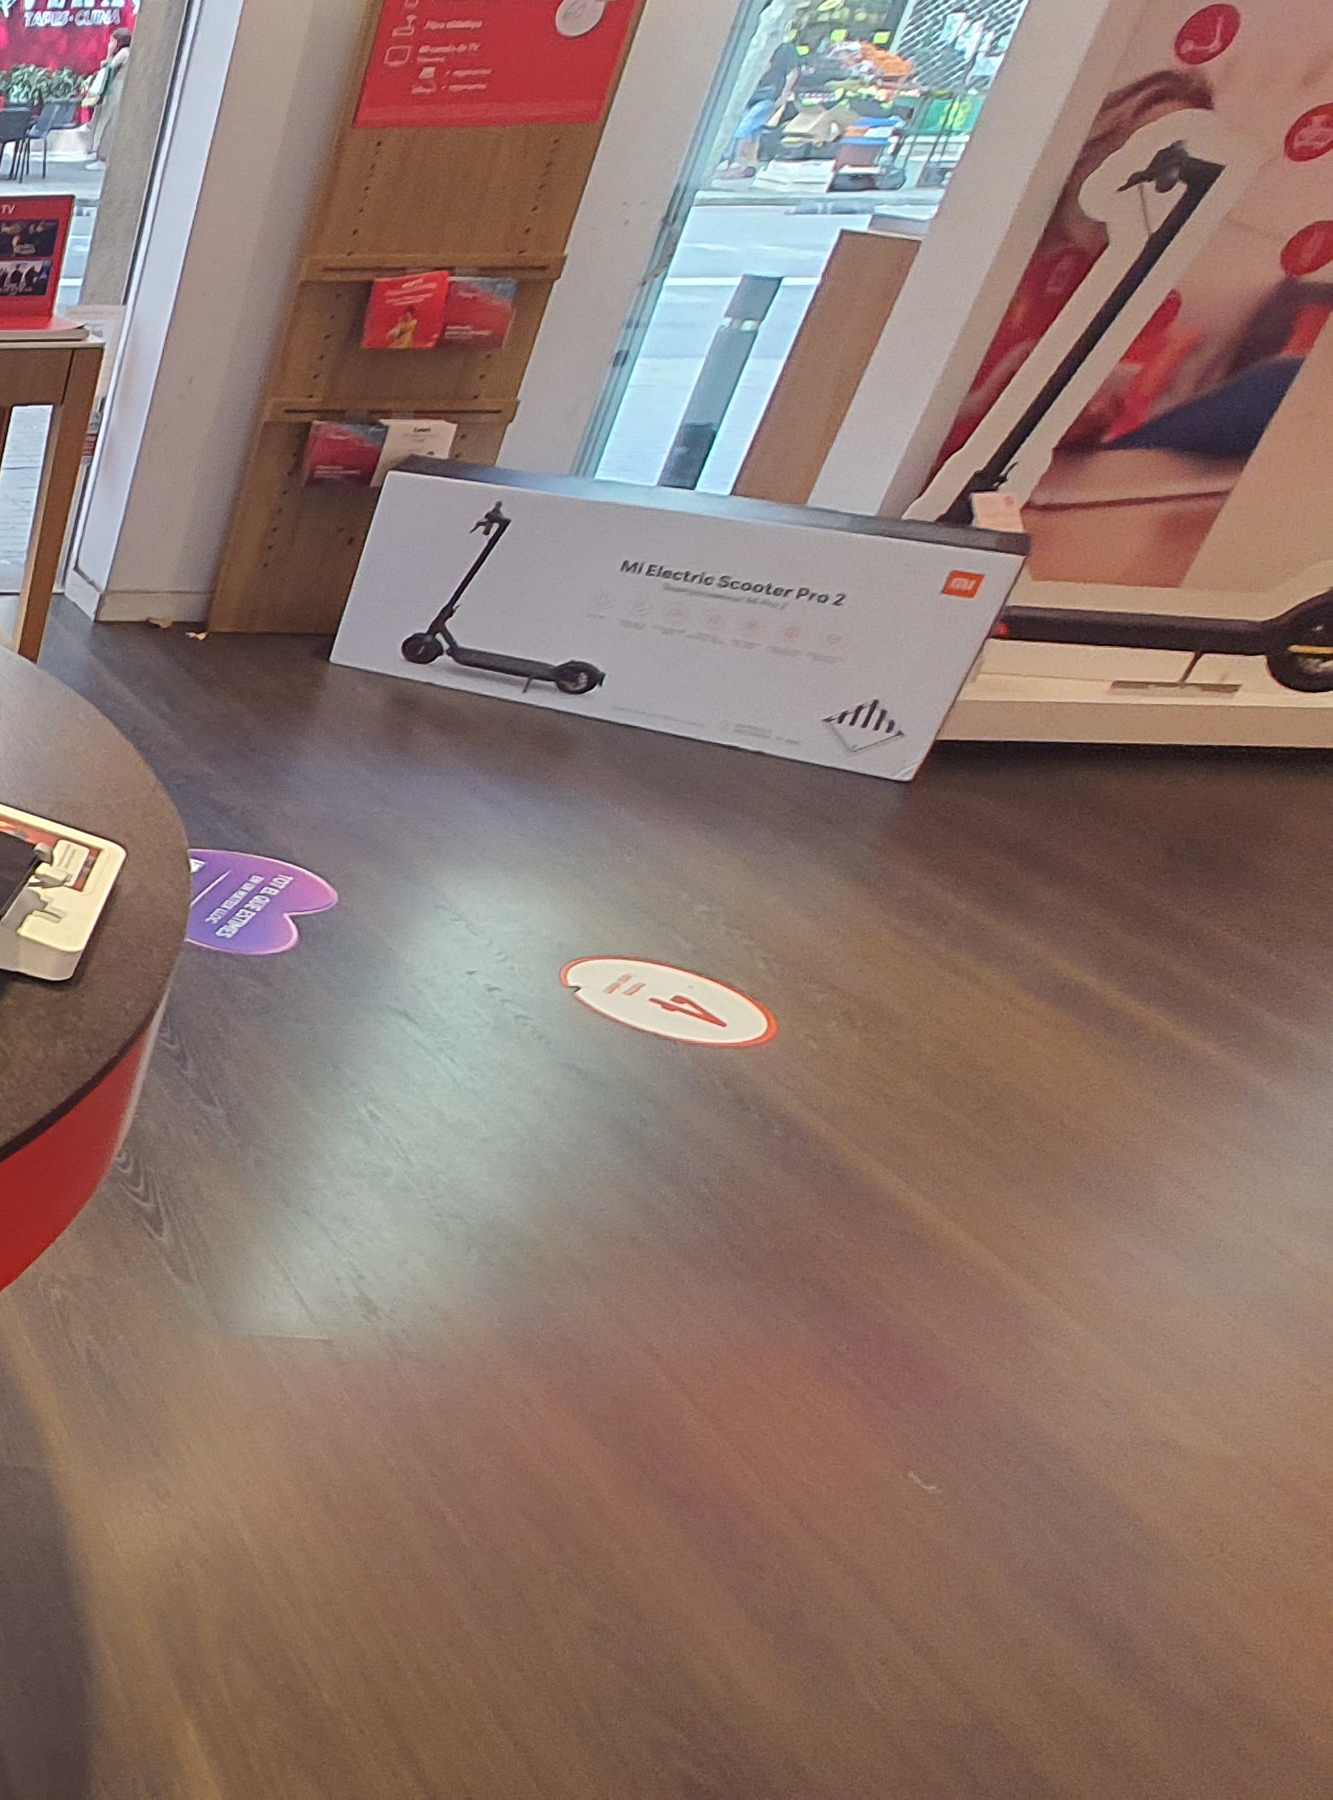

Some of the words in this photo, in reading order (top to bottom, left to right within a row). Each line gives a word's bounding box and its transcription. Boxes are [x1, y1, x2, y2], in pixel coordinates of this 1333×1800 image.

[1, 204, 15, 215] TV
[619, 559, 644, 578] Mi
[645, 563, 714, 588] Electric
[717, 573, 794, 598] Scooter
[794, 586, 830, 604] Pro
[832, 592, 848, 606] 2
[269, 874, 295, 890] TOT
